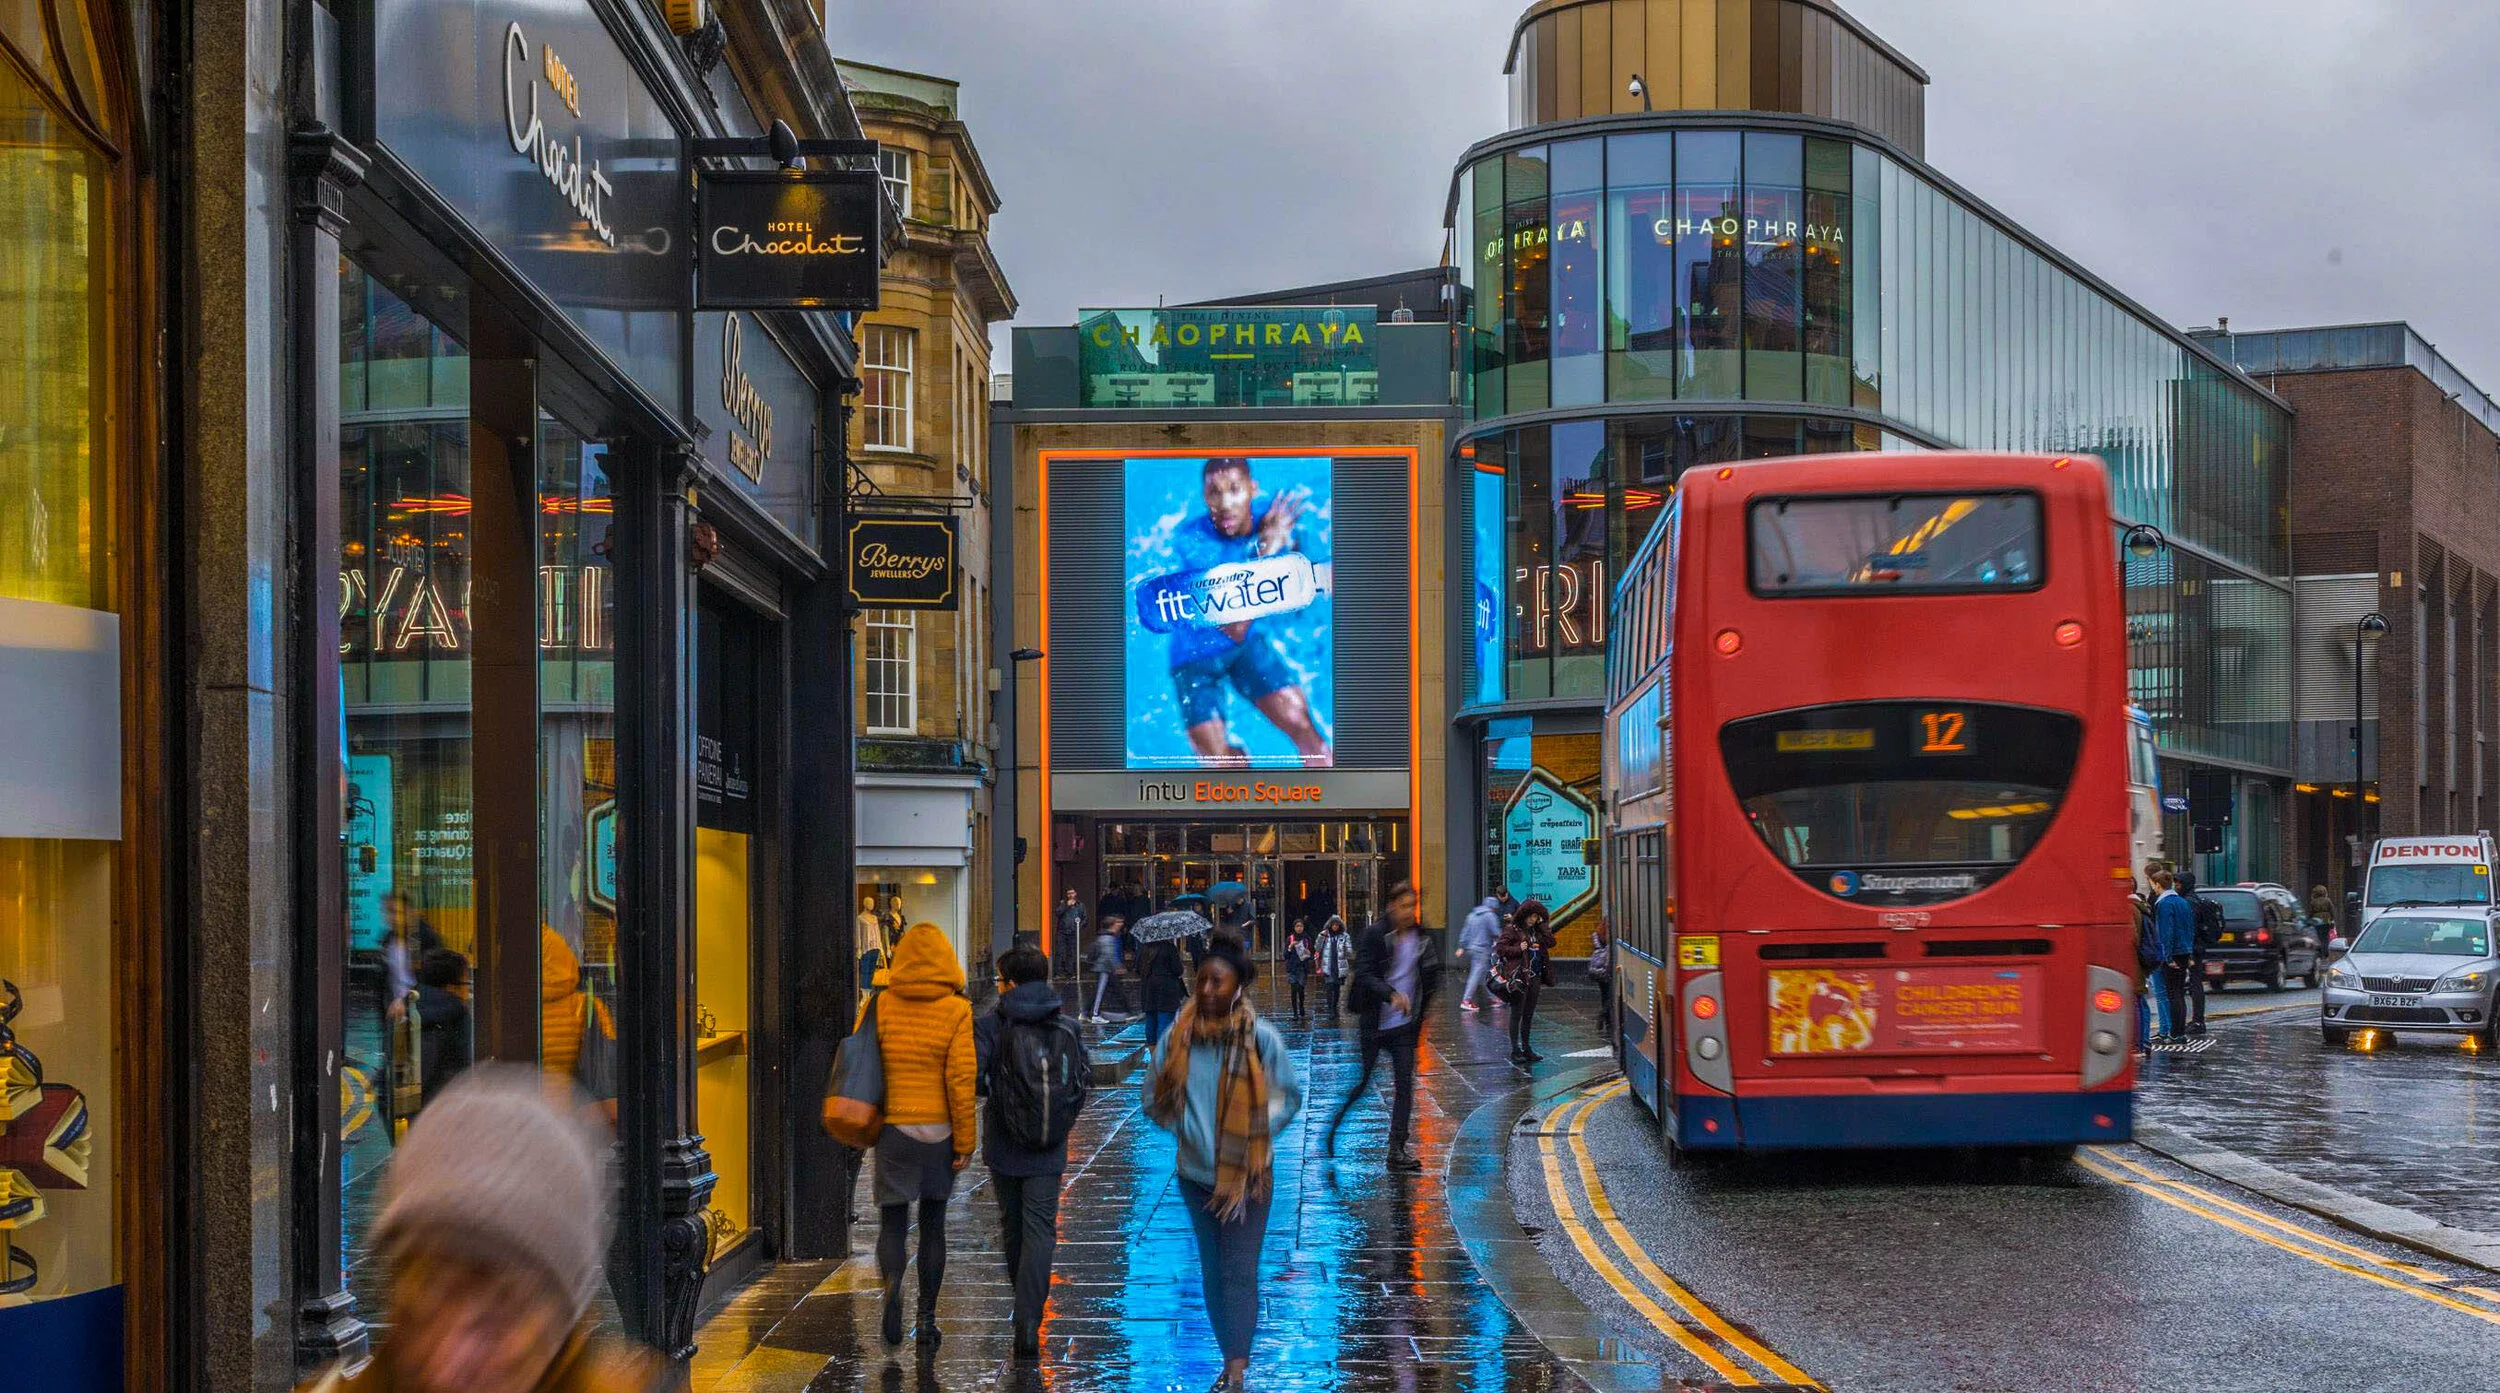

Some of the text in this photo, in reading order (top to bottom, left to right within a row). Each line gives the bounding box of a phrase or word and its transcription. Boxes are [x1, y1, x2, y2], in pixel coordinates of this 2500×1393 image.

[543, 43, 581, 119] HOTEL
[768, 222, 813, 232] HOTEL
[1653, 217, 1845, 243] CHAOPHRAYA
[1091, 323, 1365, 347] CHAOPHRAYA
[724, 310, 772, 486] Berrys
[858, 542, 945, 579] Berrys
[870, 569, 912, 578] JEWELLERS
[1920, 712, 1968, 752] 12
[698, 735, 722, 762] OFFICINE
[698, 760, 722, 787] PANERAI
[1139, 779, 1322, 805] intu Eldon Square
[2381, 845, 2480, 859] DENTON
[1558, 867, 1586, 876] TAPAS
[1896, 1000, 1976, 1017] CANCER
[2373, 995, 2419, 1007] BX62 BZF
